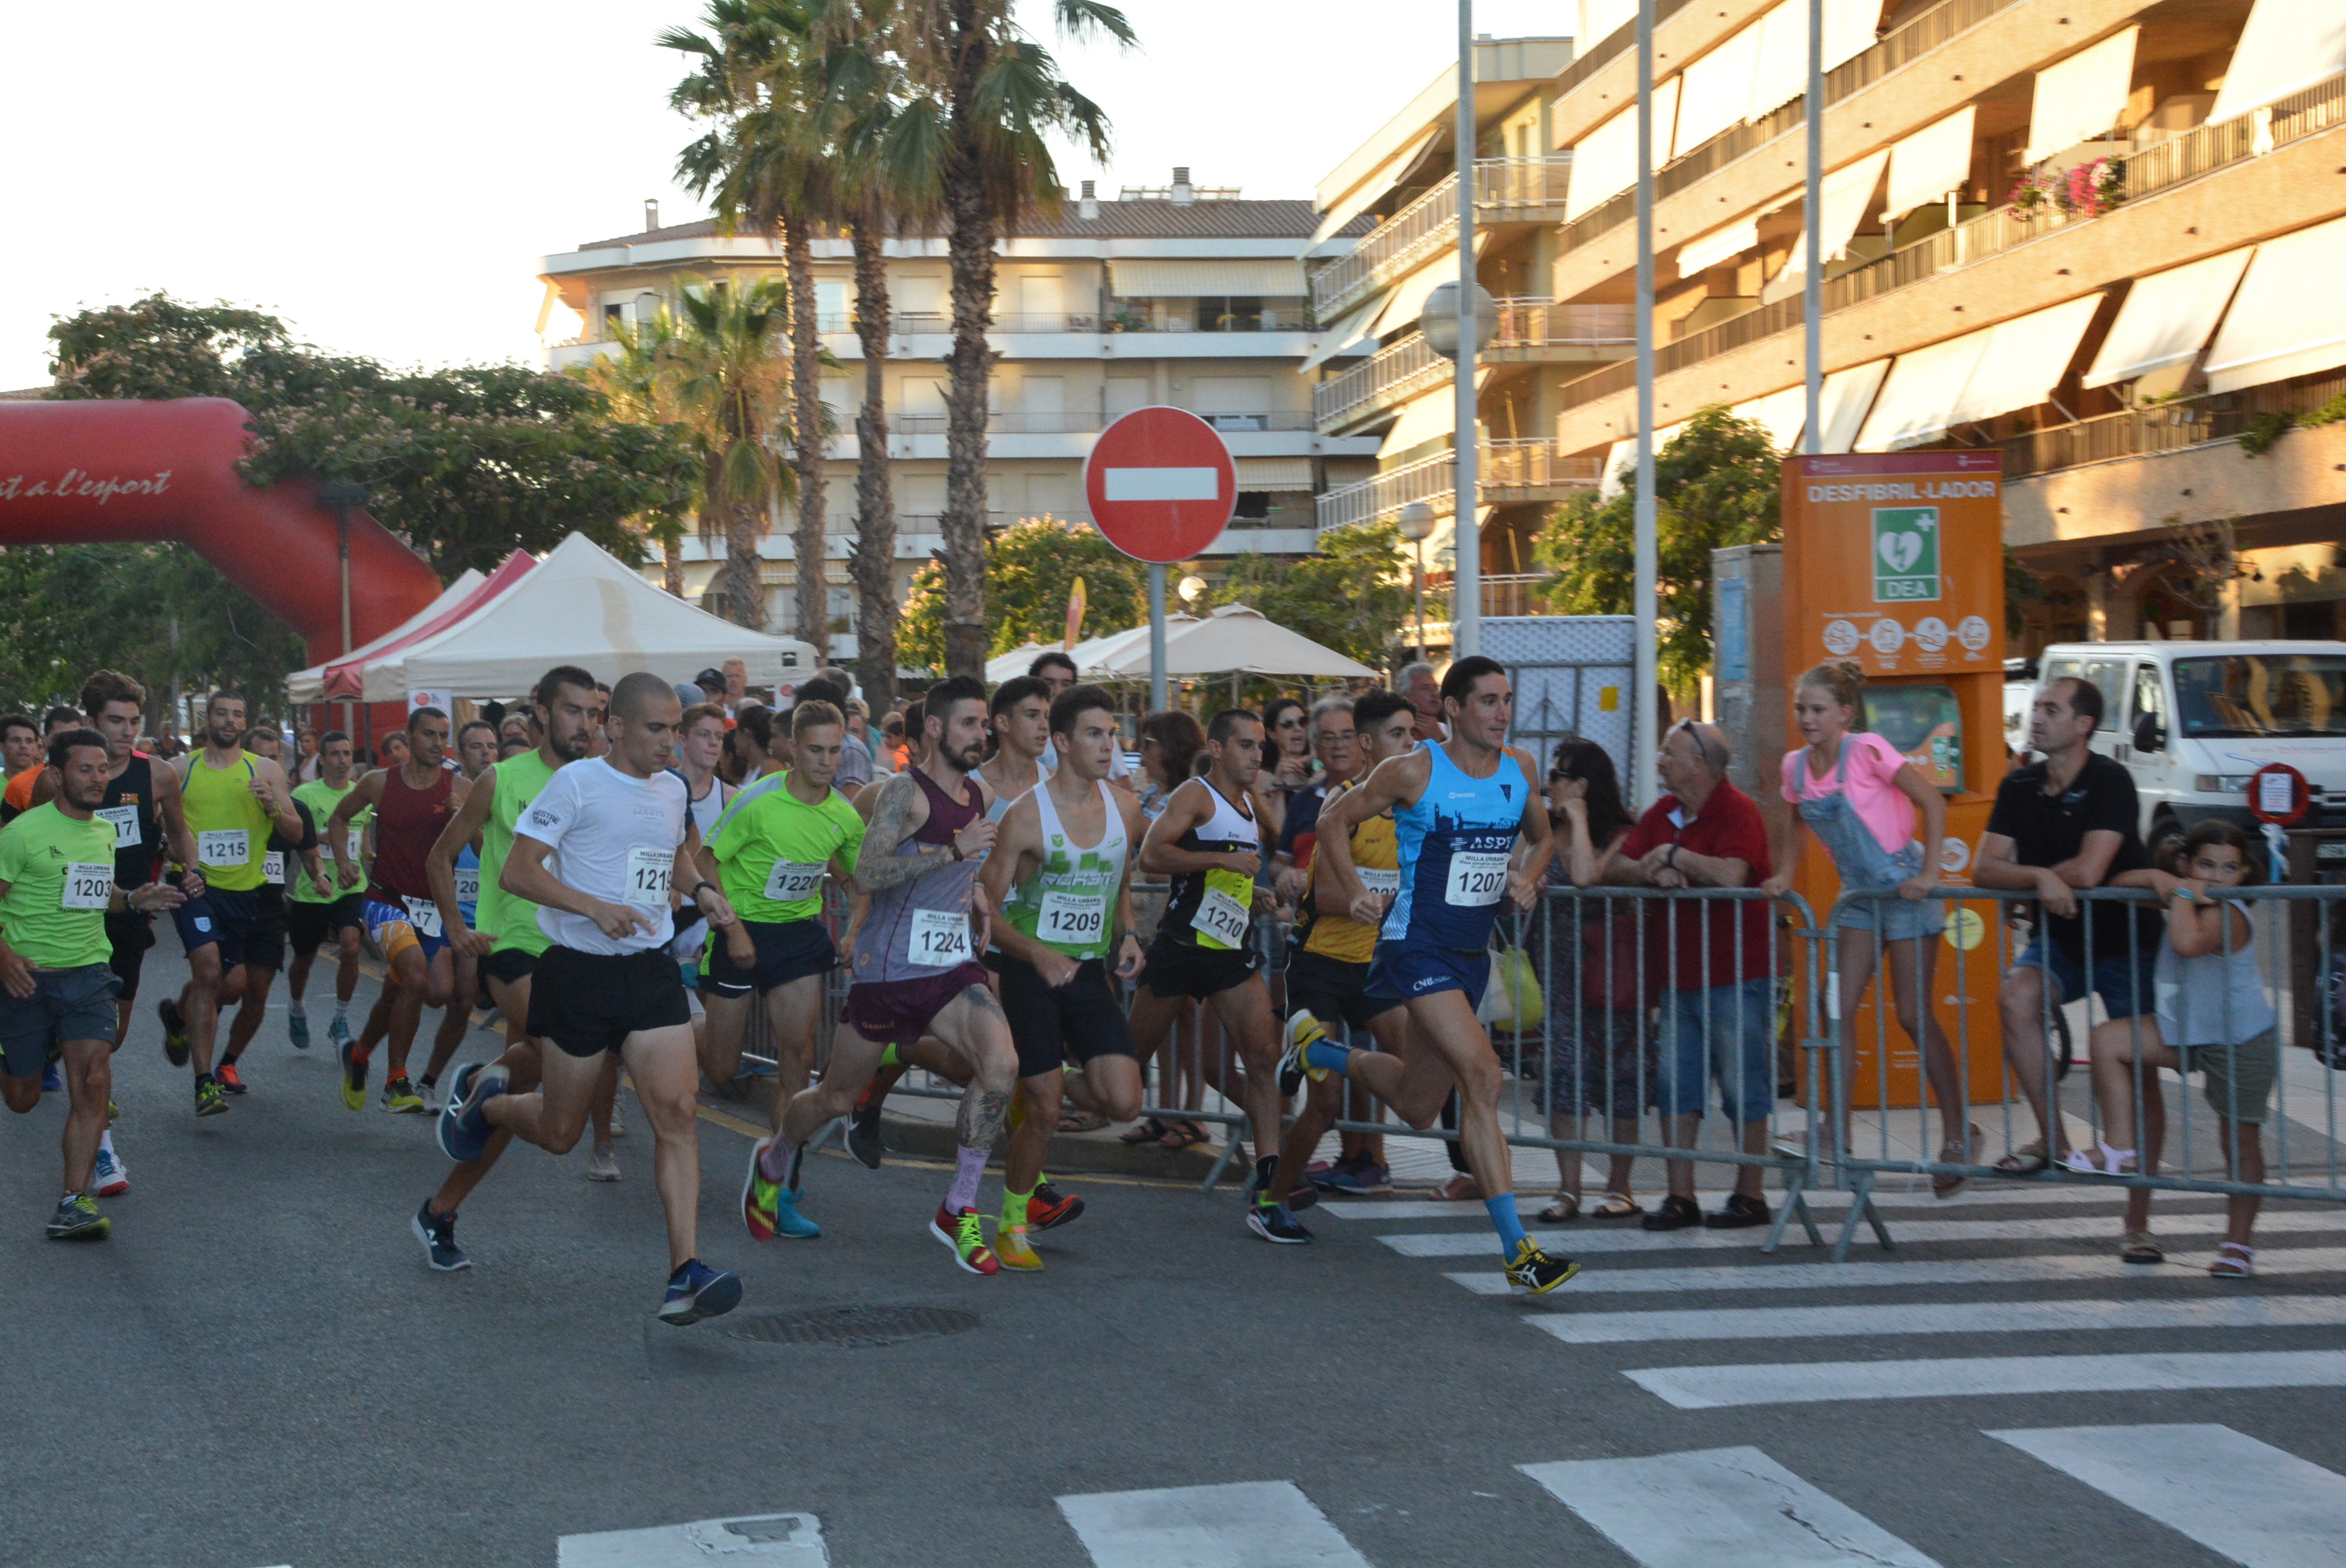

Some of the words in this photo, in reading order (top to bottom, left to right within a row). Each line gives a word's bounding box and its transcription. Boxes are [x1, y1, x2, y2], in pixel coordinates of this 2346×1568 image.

[0, 475, 24, 500] t
[25, 481, 50, 497] a
[53, 468, 171, 505] l'esport
[1887, 581, 1928, 597] DEA
[205, 842, 245, 858] 1215
[74, 879, 111, 898] 1203
[778, 874, 820, 891] 1220
[1458, 871, 1505, 893] 1207
[1049, 910, 1101, 931] 1209
[1208, 906, 1244, 938] 1210
[921, 931, 965, 953] 1224
